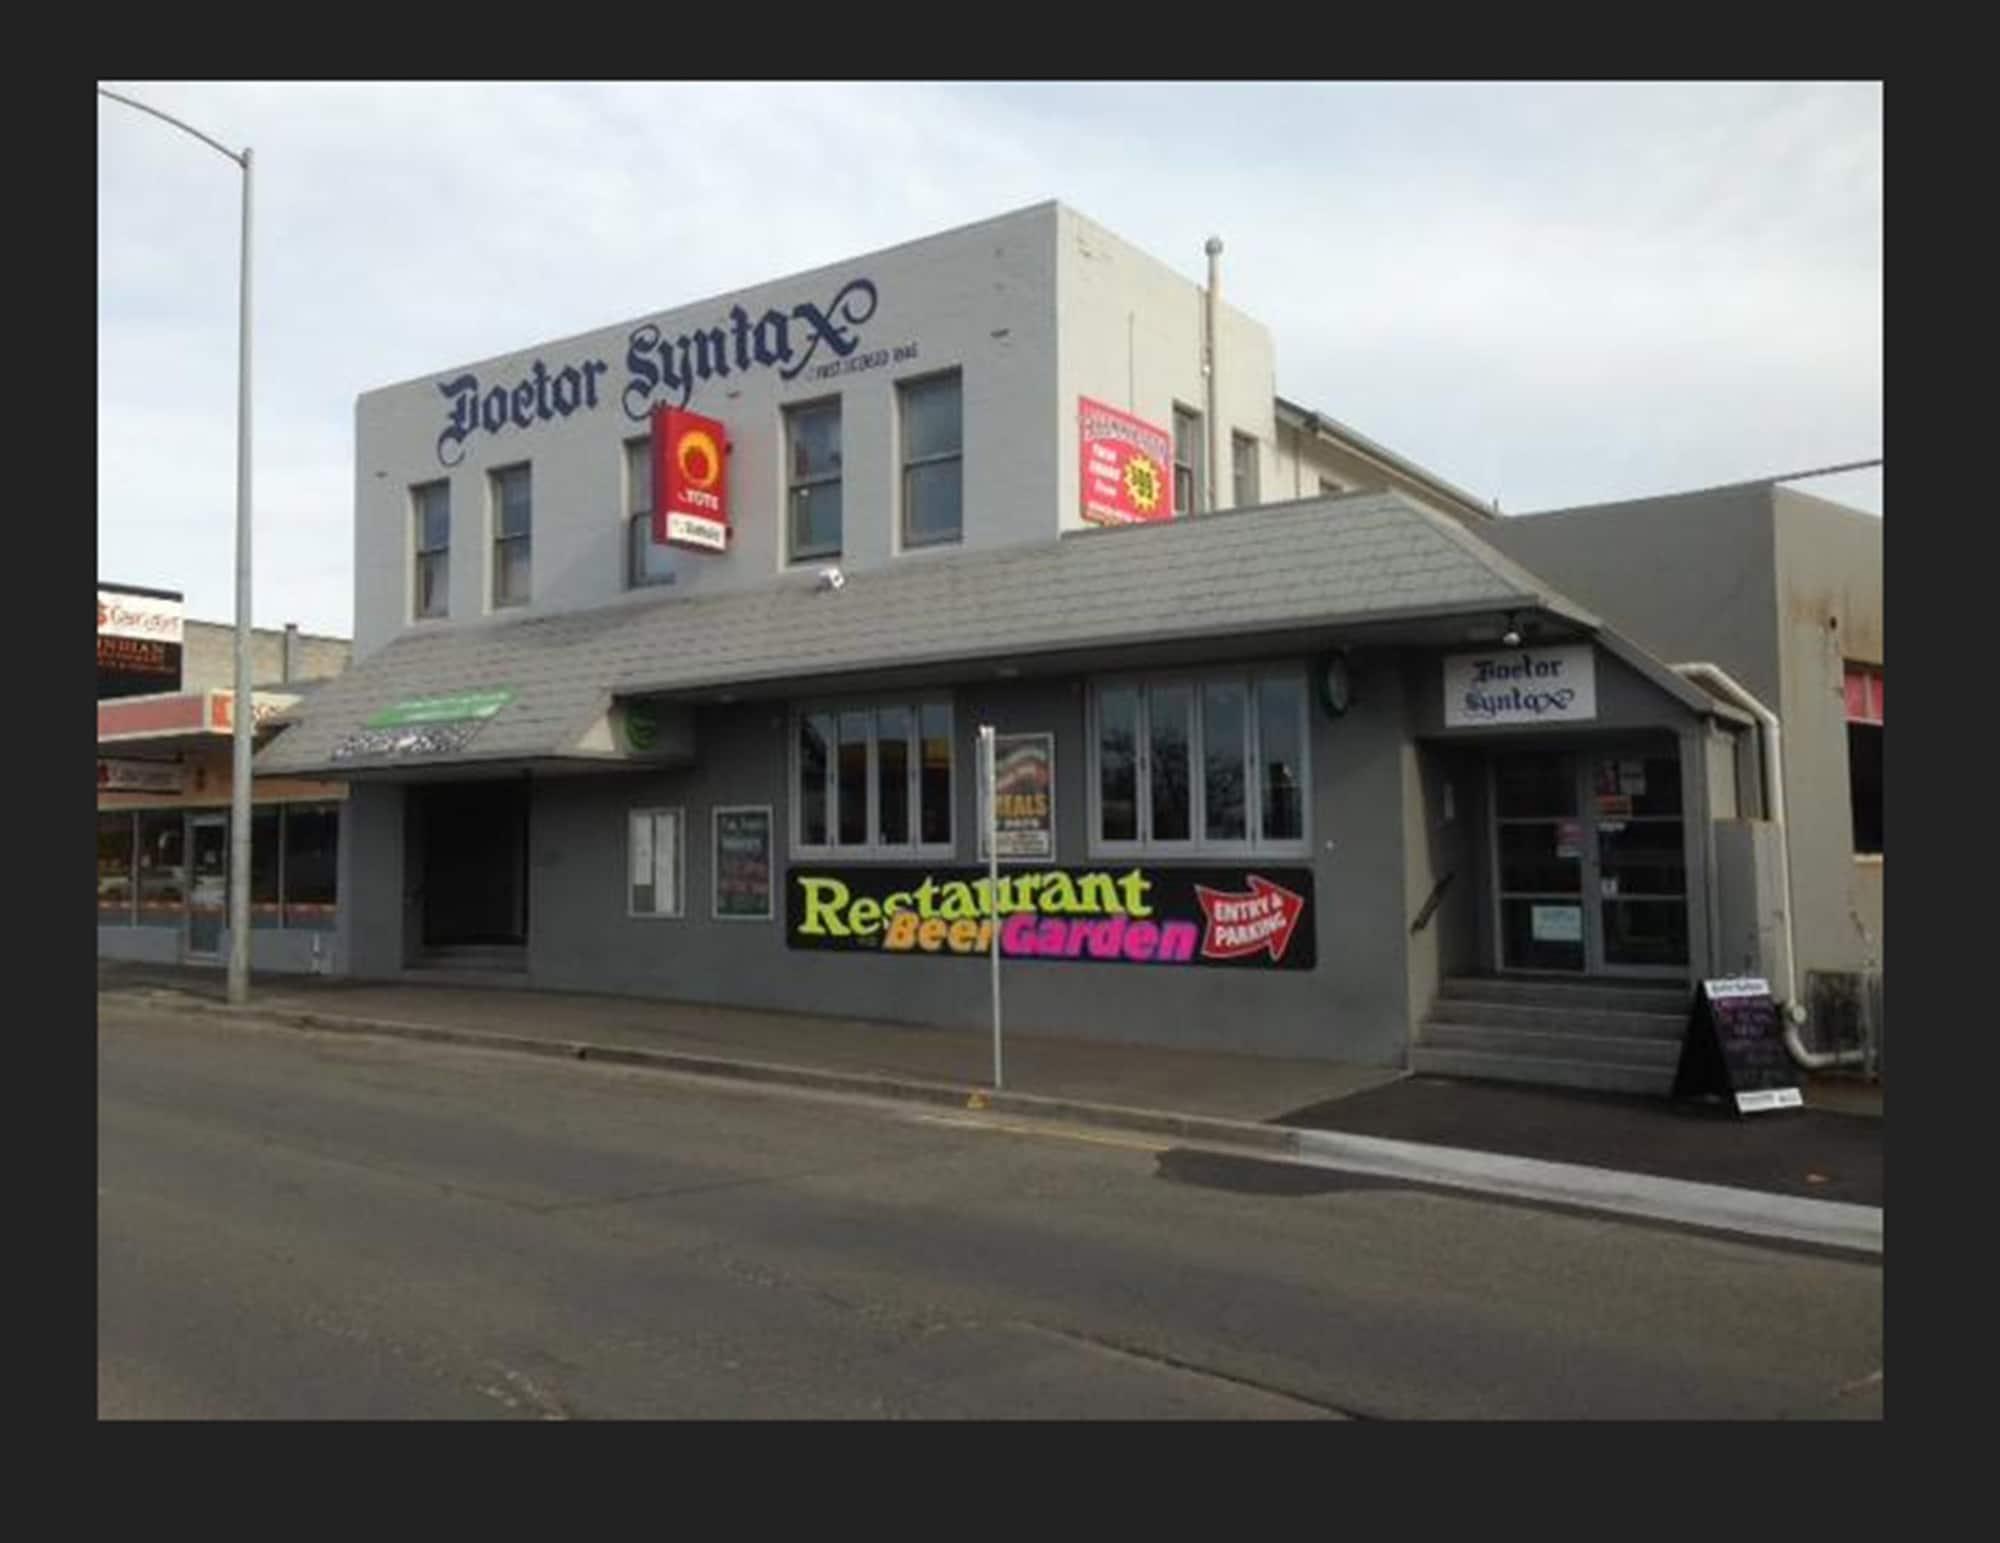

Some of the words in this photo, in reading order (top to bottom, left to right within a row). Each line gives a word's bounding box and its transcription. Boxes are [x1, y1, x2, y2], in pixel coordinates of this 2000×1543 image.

[438, 360, 608, 467] Doctor
[623, 278, 877, 422] Syntax
[1472, 653, 1563, 683] Doctor
[1465, 687, 1575, 718] Syntax
[797, 869, 1153, 935] Restaurant
[1214, 895, 1270, 922] ENTRY
[1001, 914, 1198, 961] Garden
[1214, 911, 1287, 947] PARKING
